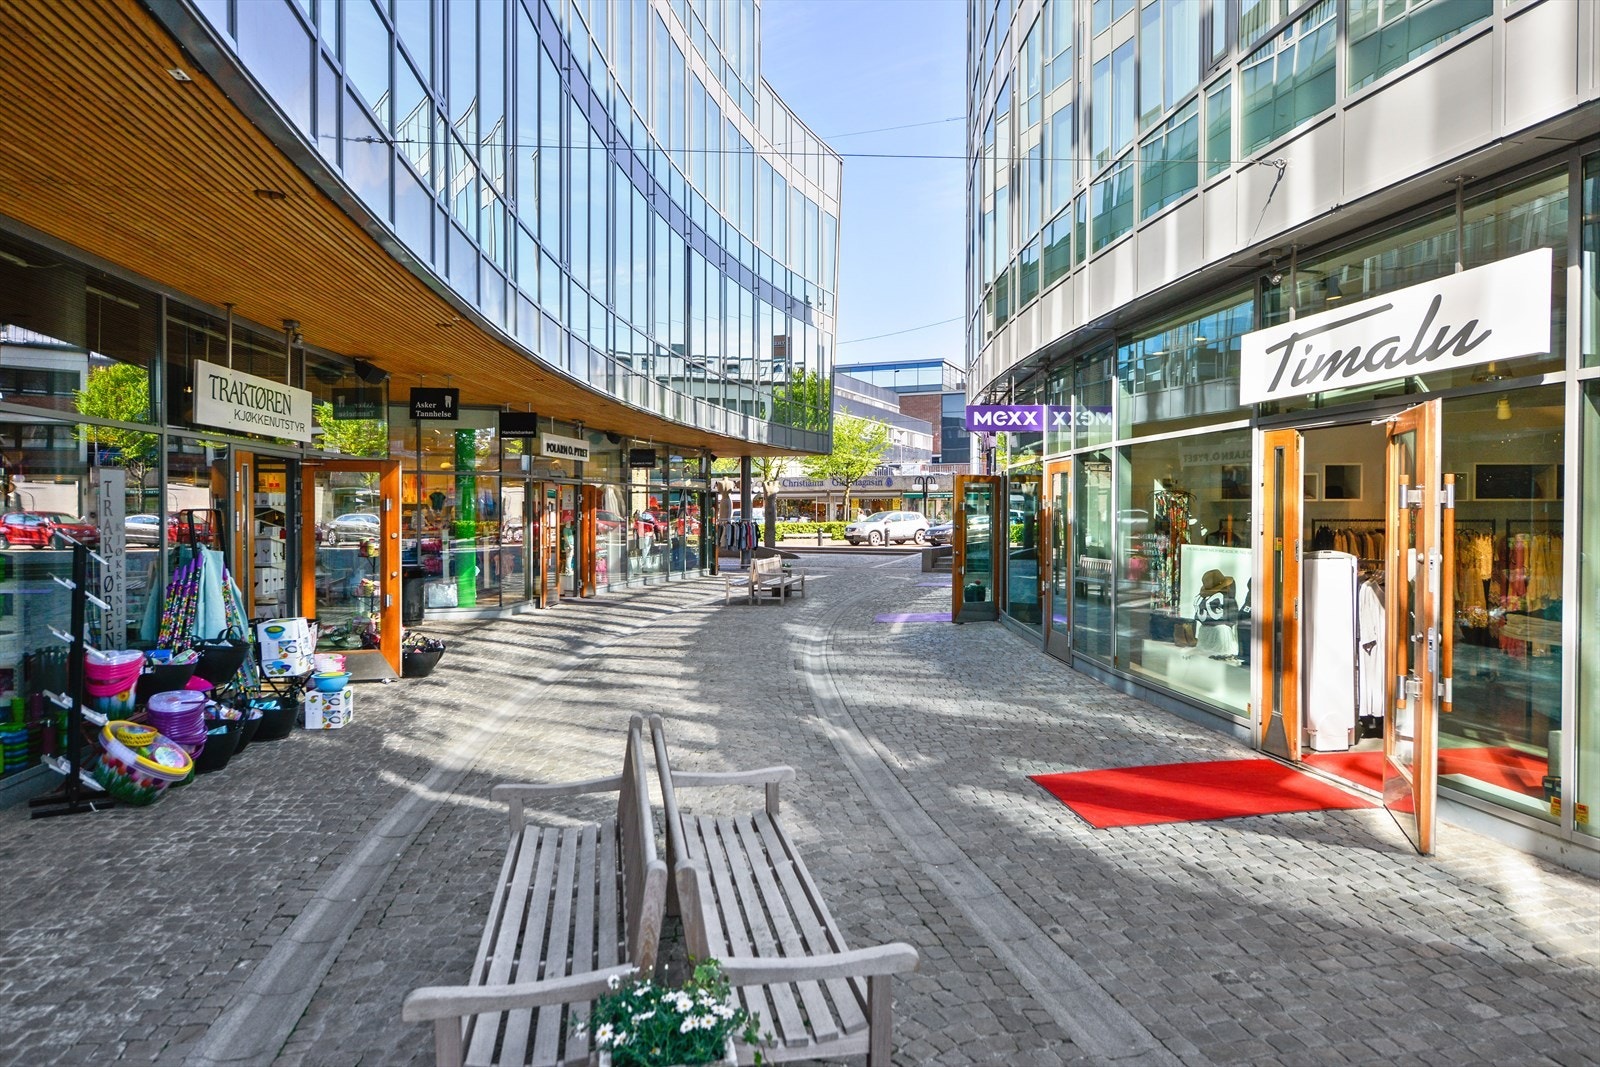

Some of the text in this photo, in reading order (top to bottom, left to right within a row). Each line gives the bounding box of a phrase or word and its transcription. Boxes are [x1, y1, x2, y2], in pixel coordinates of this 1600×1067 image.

[1265, 294, 1492, 392] Timalu
[208, 374, 292, 416] TRAKTØREN
[416, 401, 437, 409] Asker
[233, 408, 306, 432] KJØKKENUTSTYR
[416, 410, 452, 418] Tannhelse
